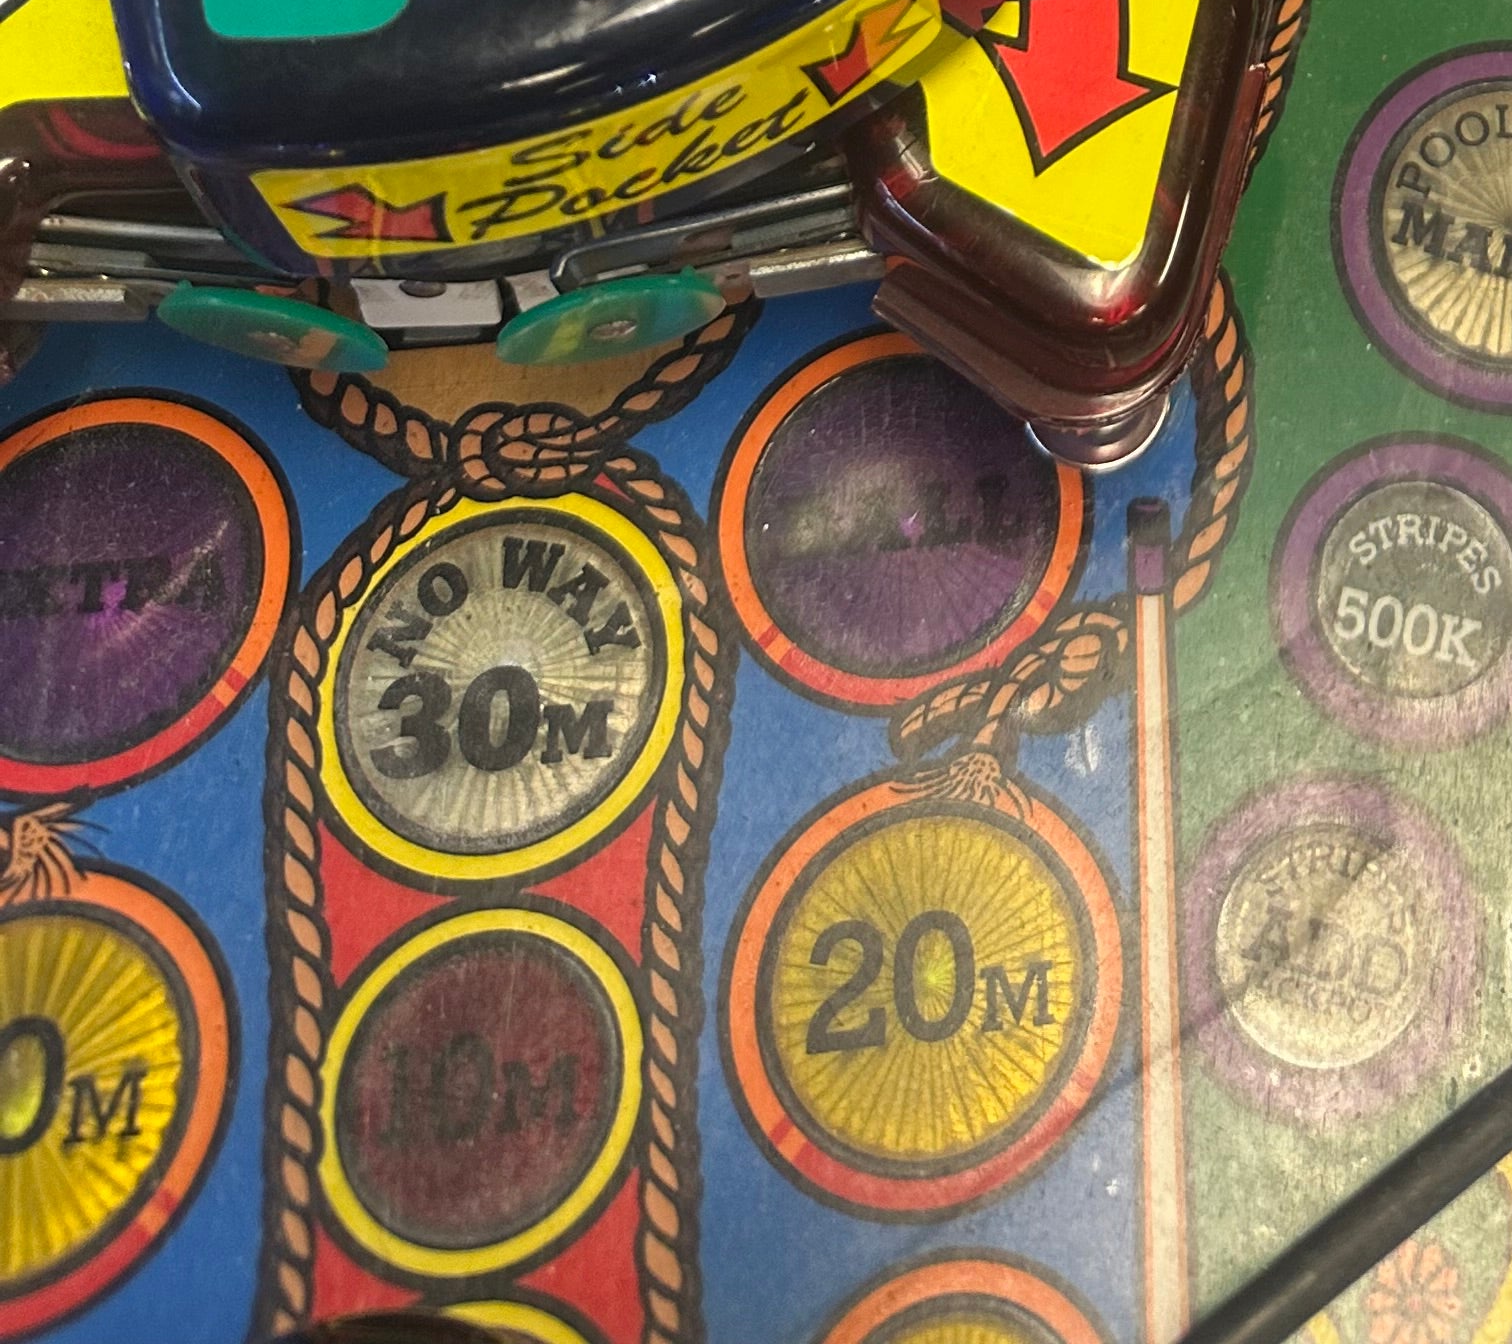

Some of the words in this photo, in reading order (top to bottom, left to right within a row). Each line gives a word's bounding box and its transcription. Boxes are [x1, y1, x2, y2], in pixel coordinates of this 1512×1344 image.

[453, 87, 808, 240] Pocket
[503, 80, 746, 188] Side
[367, 562, 470, 669] NO
[502, 536, 641, 656] WAY
[1348, 513, 1502, 595] STRIPES
[1333, 587, 1483, 669] 500K
[369, 664, 613, 780] 30M
[804, 909, 1055, 1055] 20M
